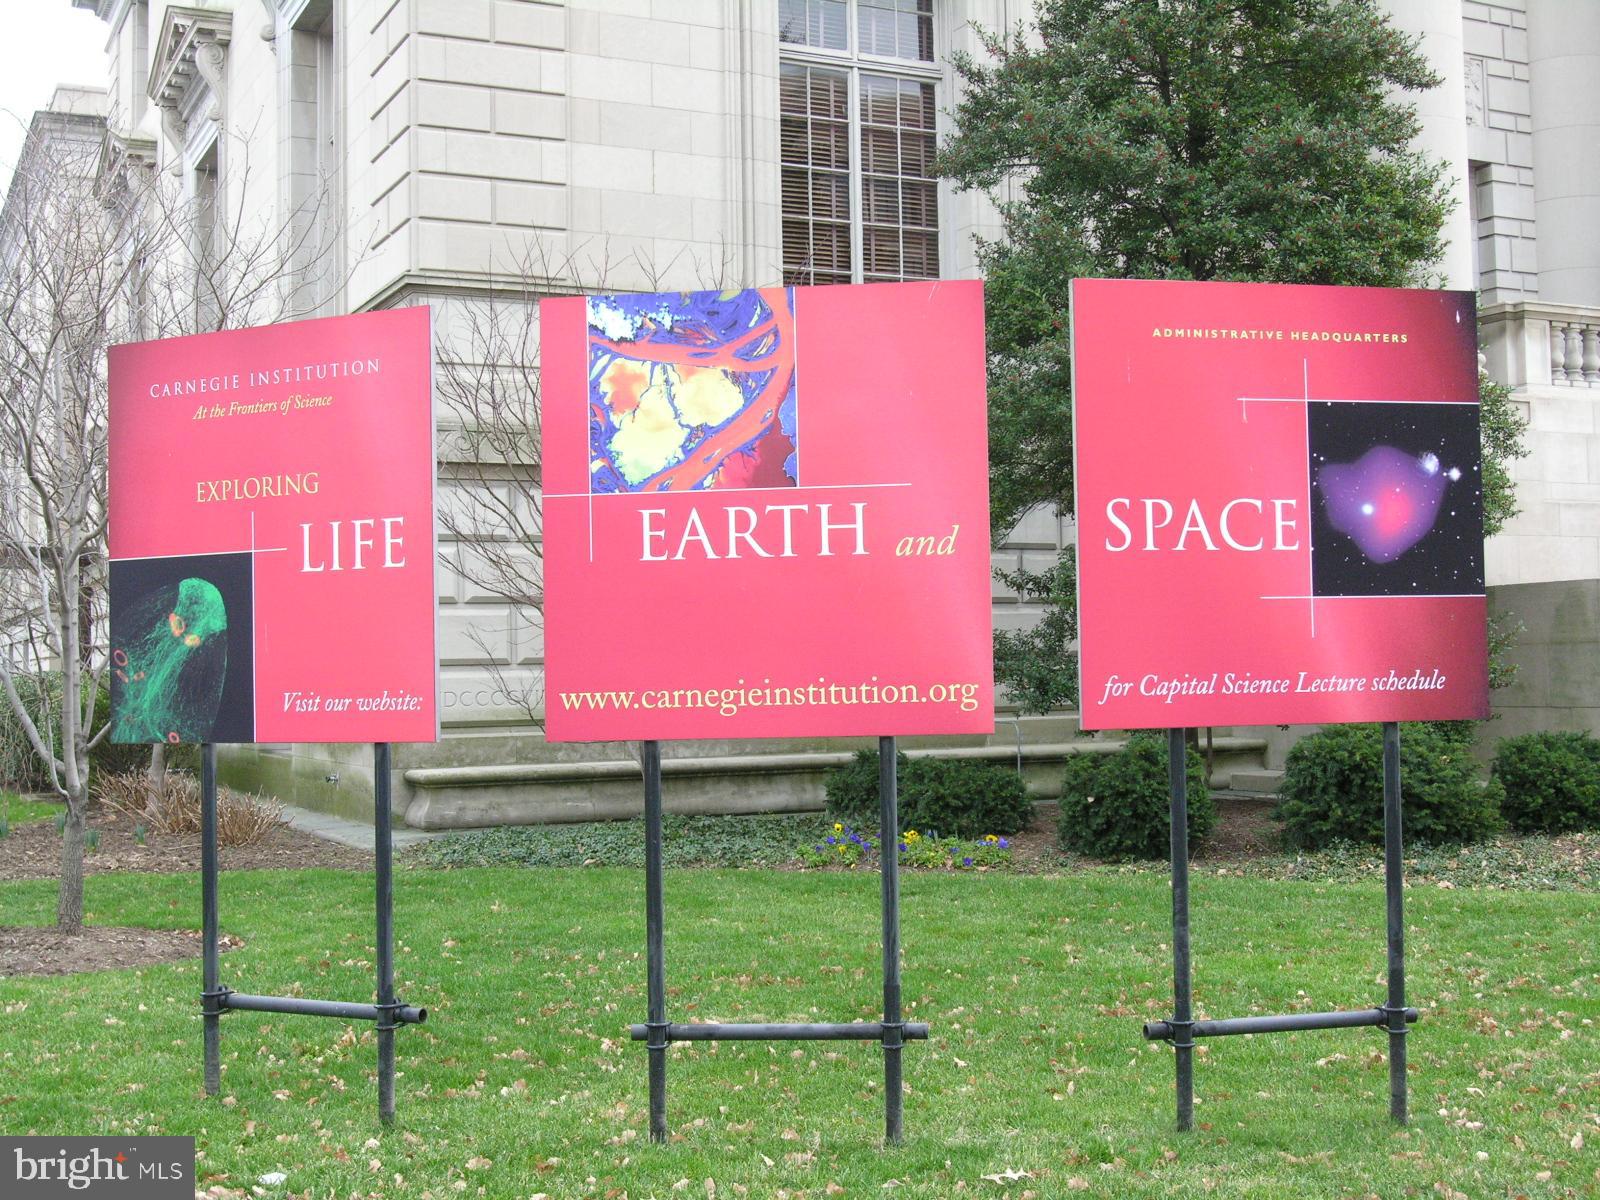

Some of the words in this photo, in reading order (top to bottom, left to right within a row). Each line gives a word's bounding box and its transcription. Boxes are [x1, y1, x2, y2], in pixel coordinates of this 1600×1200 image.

[1152, 327, 1284, 341] ADMINISTRATIVE
[1290, 329, 1409, 344] HEADQUARTERS
[150, 375, 240, 398] CARNEGIE
[250, 358, 380, 387] INSTITUTION
[193, 406, 207, 421] At
[210, 402, 226, 418] the
[228, 399, 278, 417] Frontiers
[280, 396, 293, 416] of
[295, 393, 333, 409] Science
[196, 472, 319, 503] EXPLORING
[637, 502, 870, 562] EARTH
[895, 525, 960, 557] and
[1105, 496, 1300, 553] SPACE
[300, 517, 406, 573] LIFE
[283, 692, 321, 713] Visit
[324, 696, 353, 712] our
[356, 689, 424, 711] website:
[559, 675, 980, 717] www.carnegieinstitution.org
[1097, 675, 1134, 705] for
[1139, 672, 1218, 704] Capital
[1221, 671, 1290, 695] Science
[1294, 670, 1367, 694] Lecture
[1370, 668, 1446, 692] schedule
